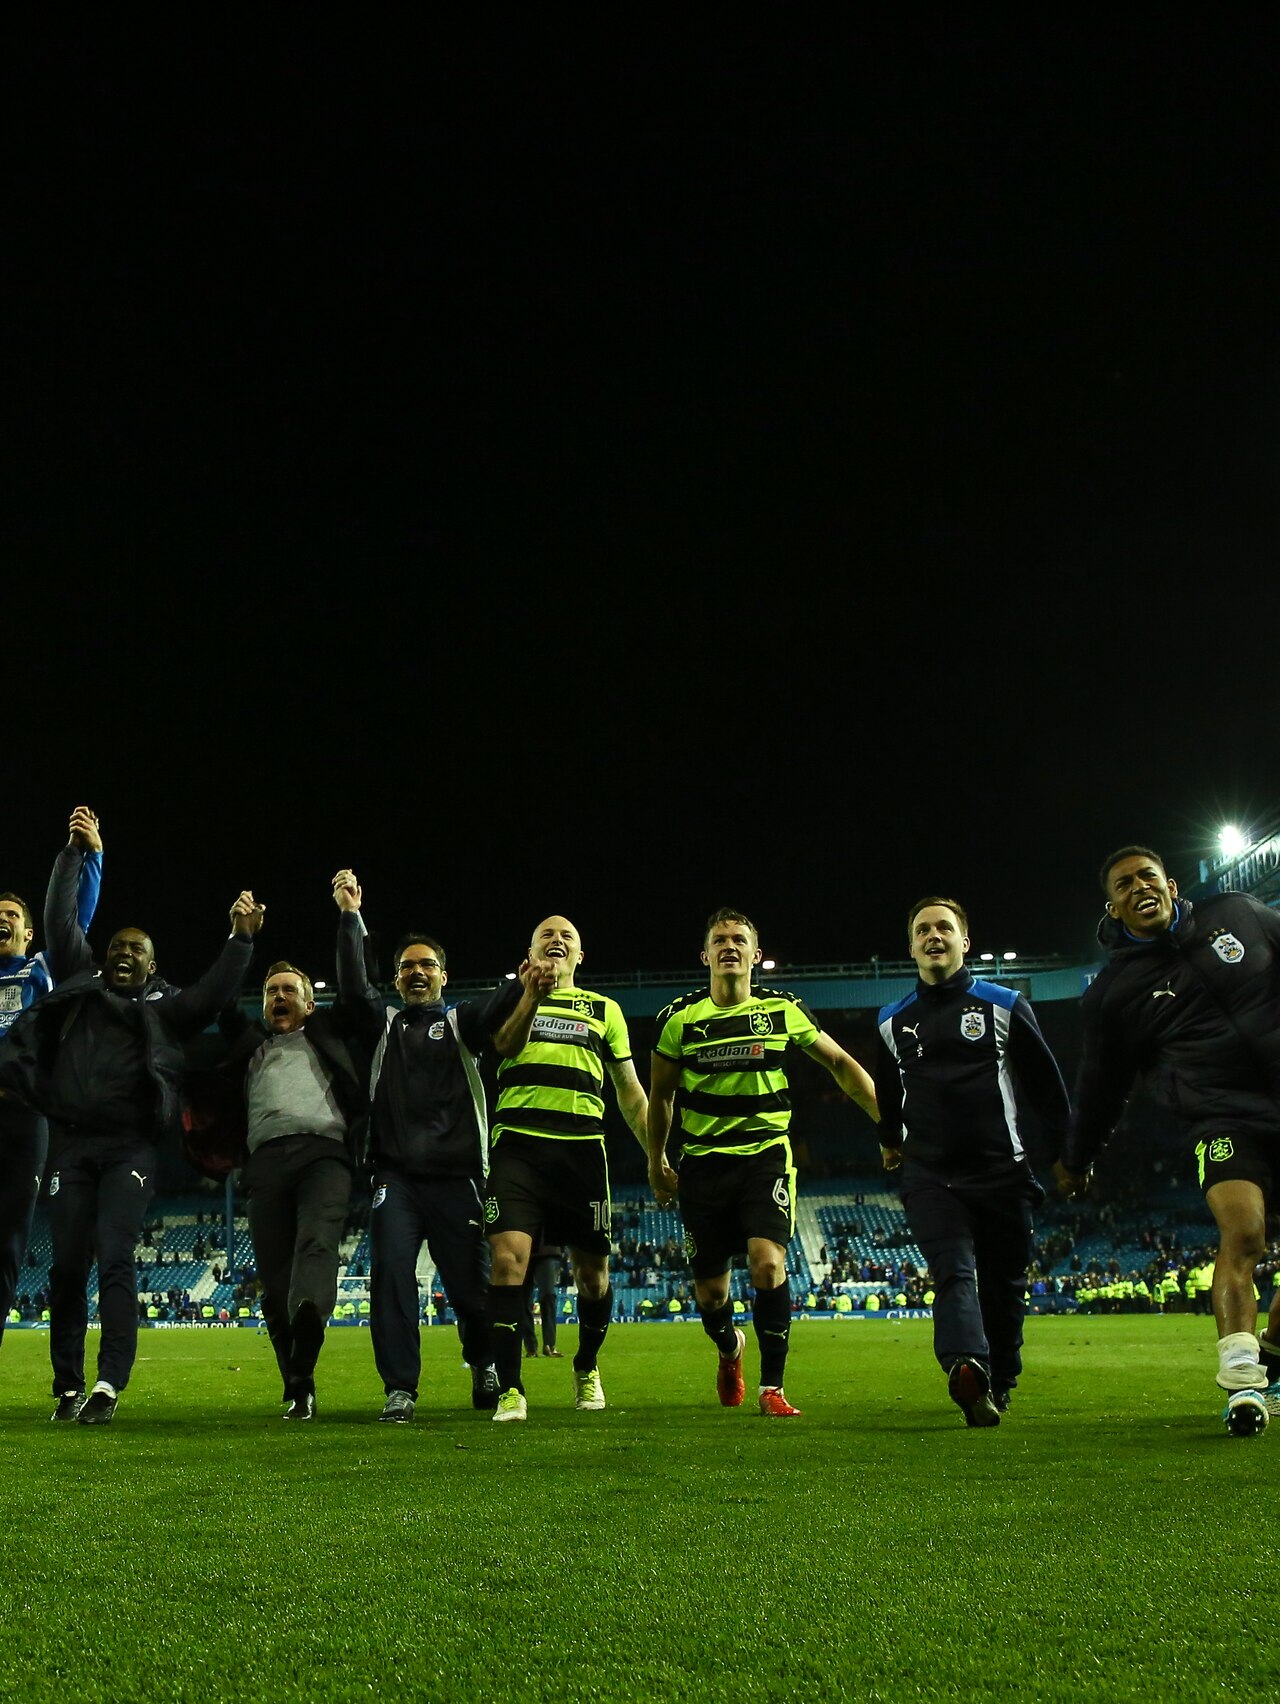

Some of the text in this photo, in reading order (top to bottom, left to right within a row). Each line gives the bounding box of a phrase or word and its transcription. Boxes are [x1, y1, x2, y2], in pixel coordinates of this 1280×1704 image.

[699, 1044, 761, 1059] RadianB
[772, 1178, 790, 1207] 6
[589, 1200, 612, 1231] 10
